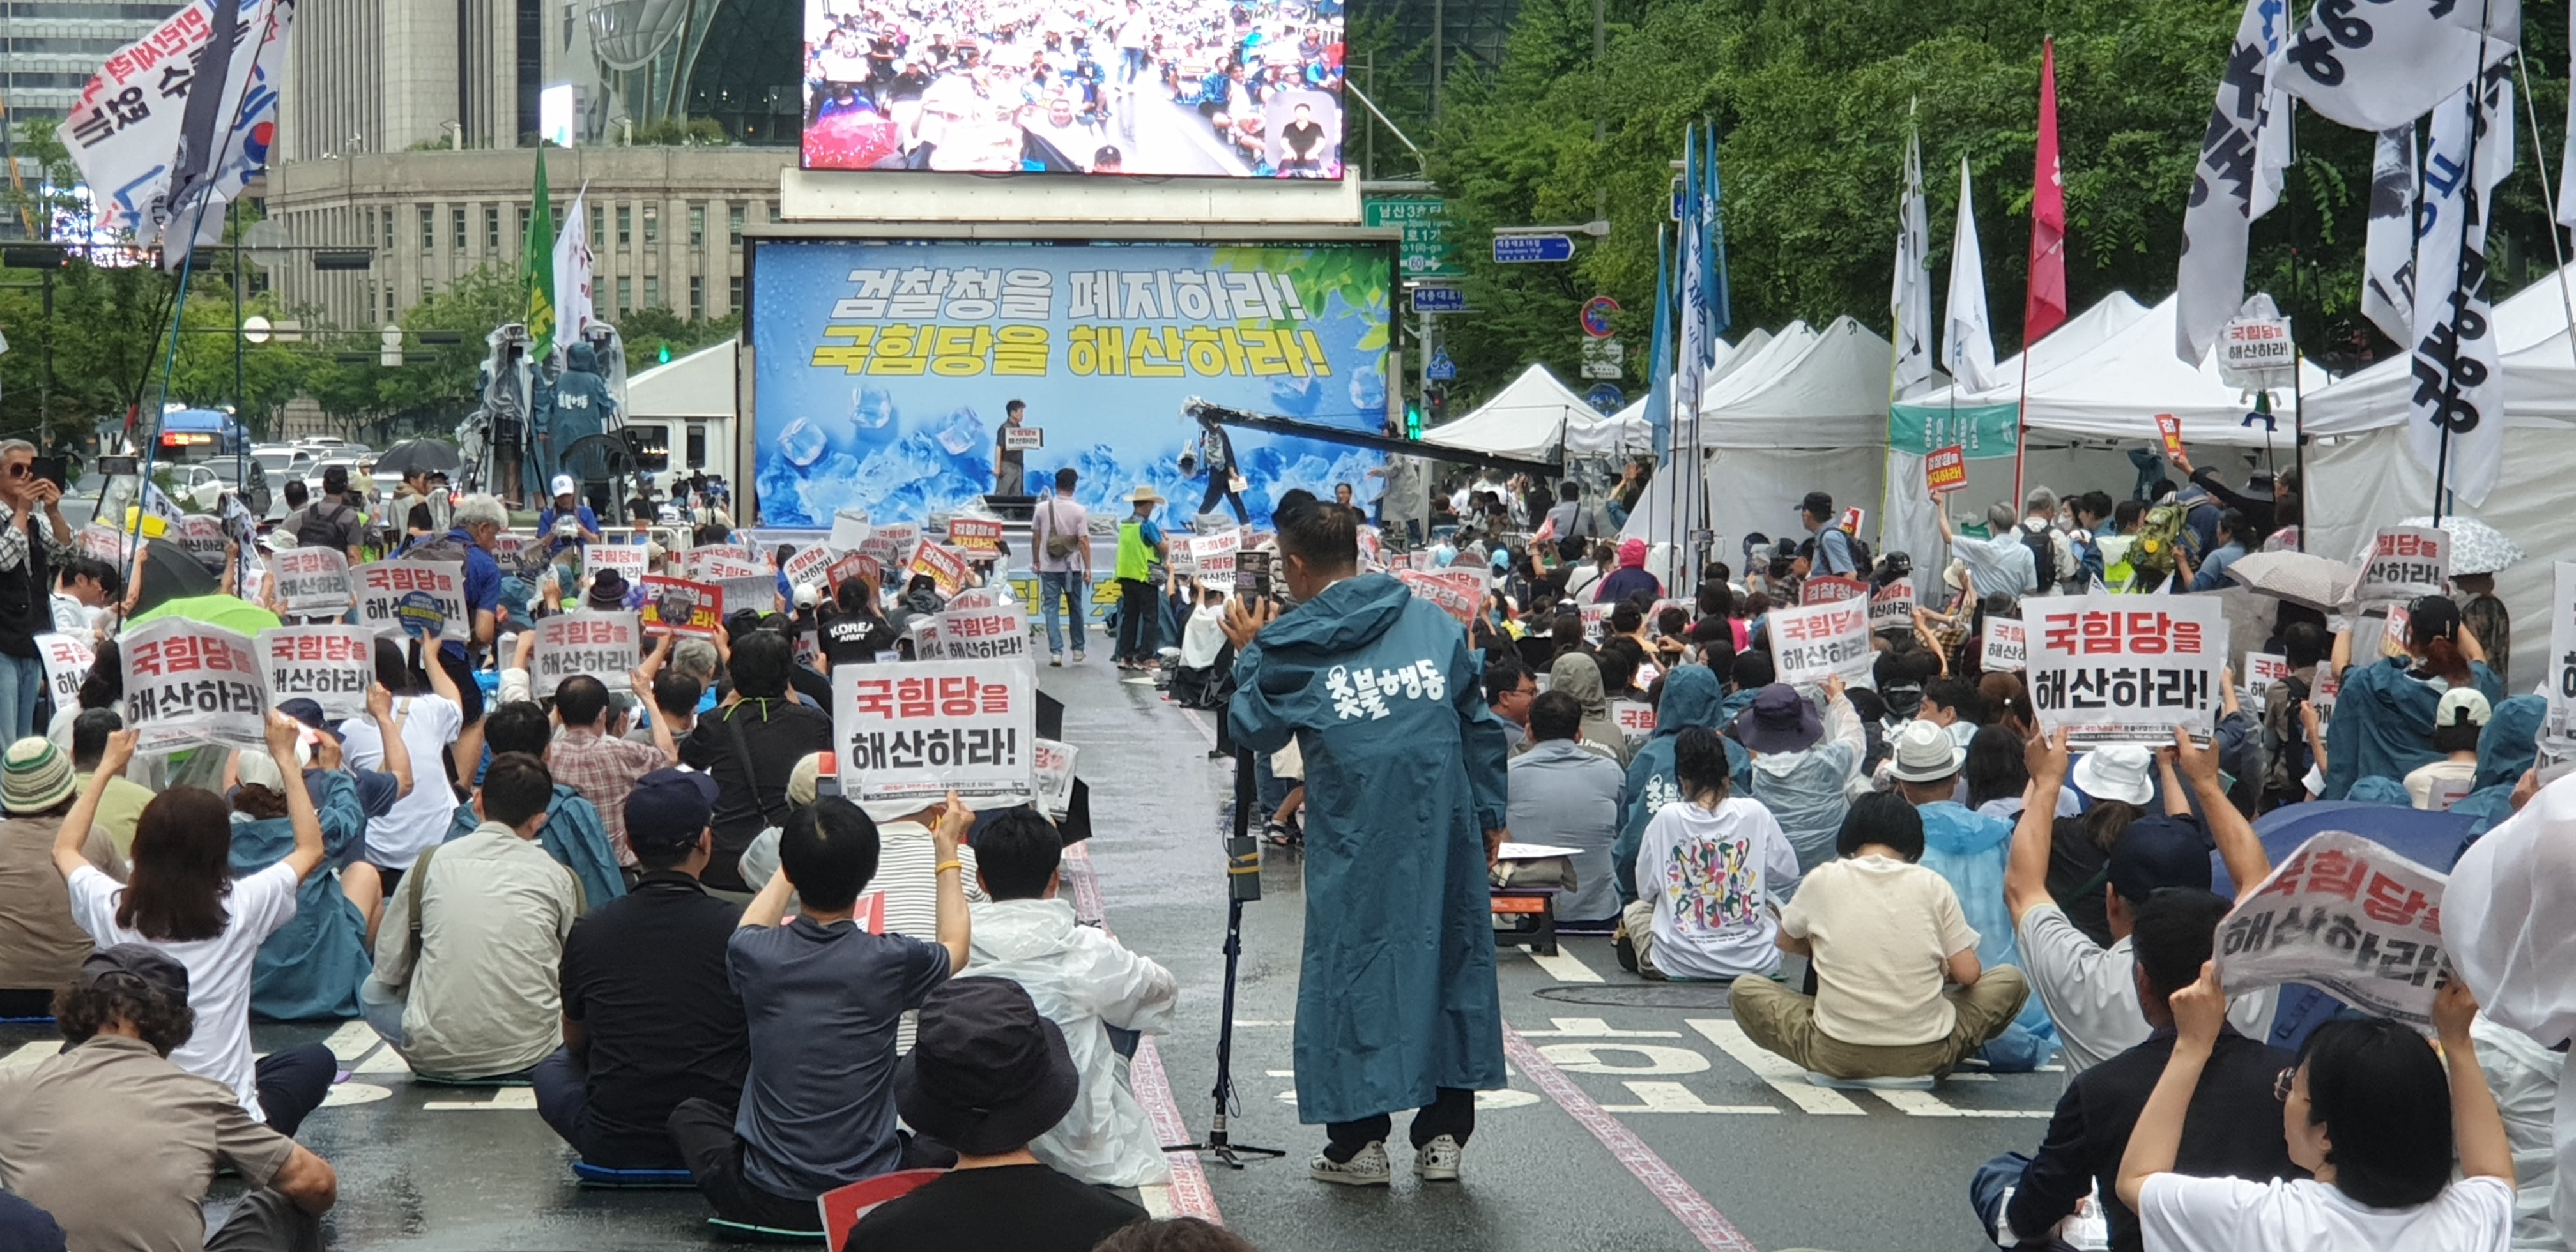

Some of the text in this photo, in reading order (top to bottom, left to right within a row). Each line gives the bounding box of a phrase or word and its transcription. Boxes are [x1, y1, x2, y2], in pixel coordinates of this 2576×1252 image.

[830, 268, 1308, 321] 검찰청을 폐지하라!
[2230, 324, 2283, 342] 국힘당을
[809, 324, 1333, 378] 국힘당을 해산하라!
[2228, 340, 2289, 360] 해산하라!
[366, 568, 453, 592] 국힘당을
[2366, 562, 2440, 586] 산하라!
[545, 622, 629, 648] 국힘당을
[830, 622, 874, 638] KOREA
[839, 633, 866, 643] ARMY
[947, 615, 1016, 638] 국힘당을
[2045, 611, 2202, 657] 국힘당을
[132, 635, 252, 678] 국힘당을
[272, 635, 368, 662] 국힘당을
[949, 636, 1022, 659] 해산하라!
[541, 649, 634, 676] 해산하라!
[856, 676, 1009, 719] 국힘당을
[1325, 659, 1445, 721] 촛불행동
[2035, 668, 2208, 711] 해산하라!
[851, 727, 1016, 770] 해산하라!
